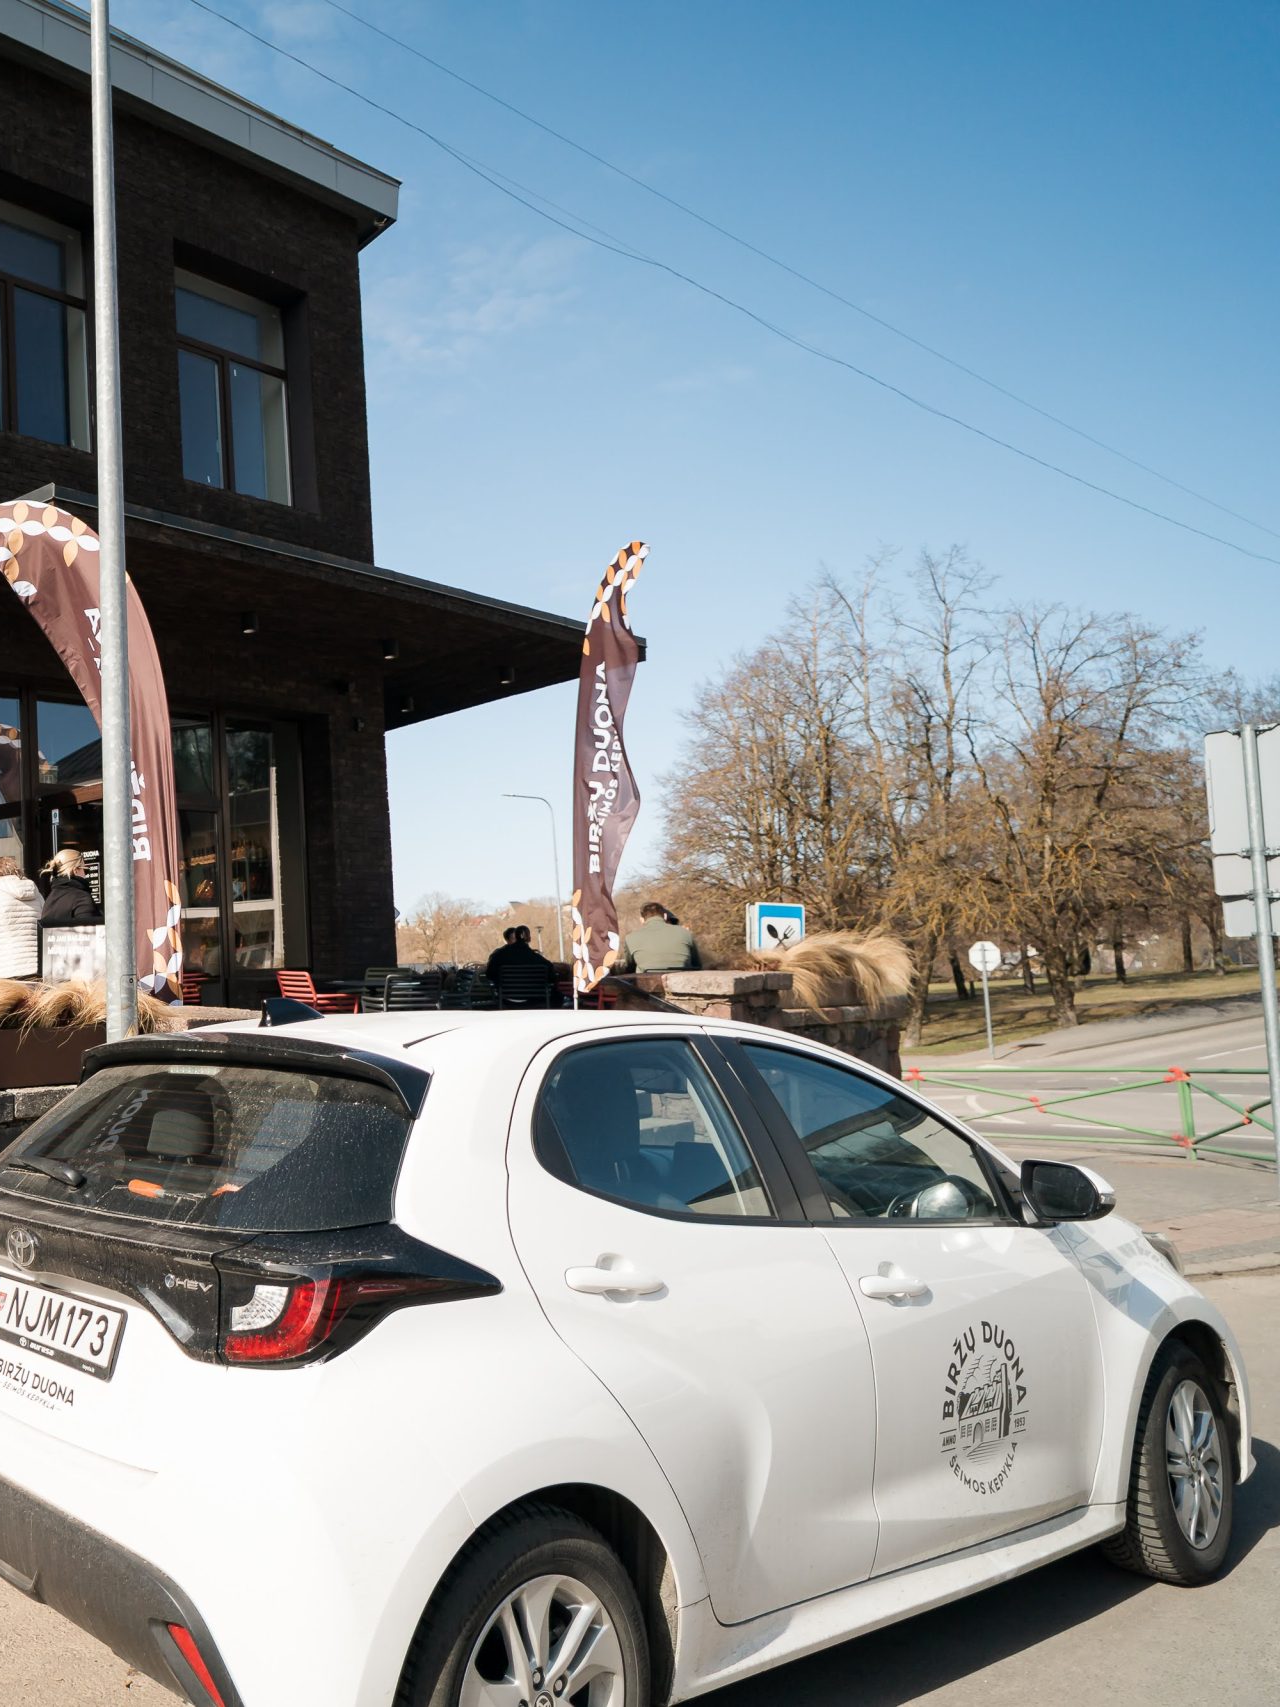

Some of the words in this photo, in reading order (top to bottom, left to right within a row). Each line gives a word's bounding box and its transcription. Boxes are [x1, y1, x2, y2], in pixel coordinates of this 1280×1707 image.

[175, 1278, 213, 1292] HEV
[31, 1373, 75, 1407] DUONA
[942, 1325, 976, 1421] BIRŽŲ
[980, 1320, 1028, 1406] DUONA
[948, 1453, 987, 1496] ŠEIMOS
[988, 1441, 1018, 1495] KEPYKLA
